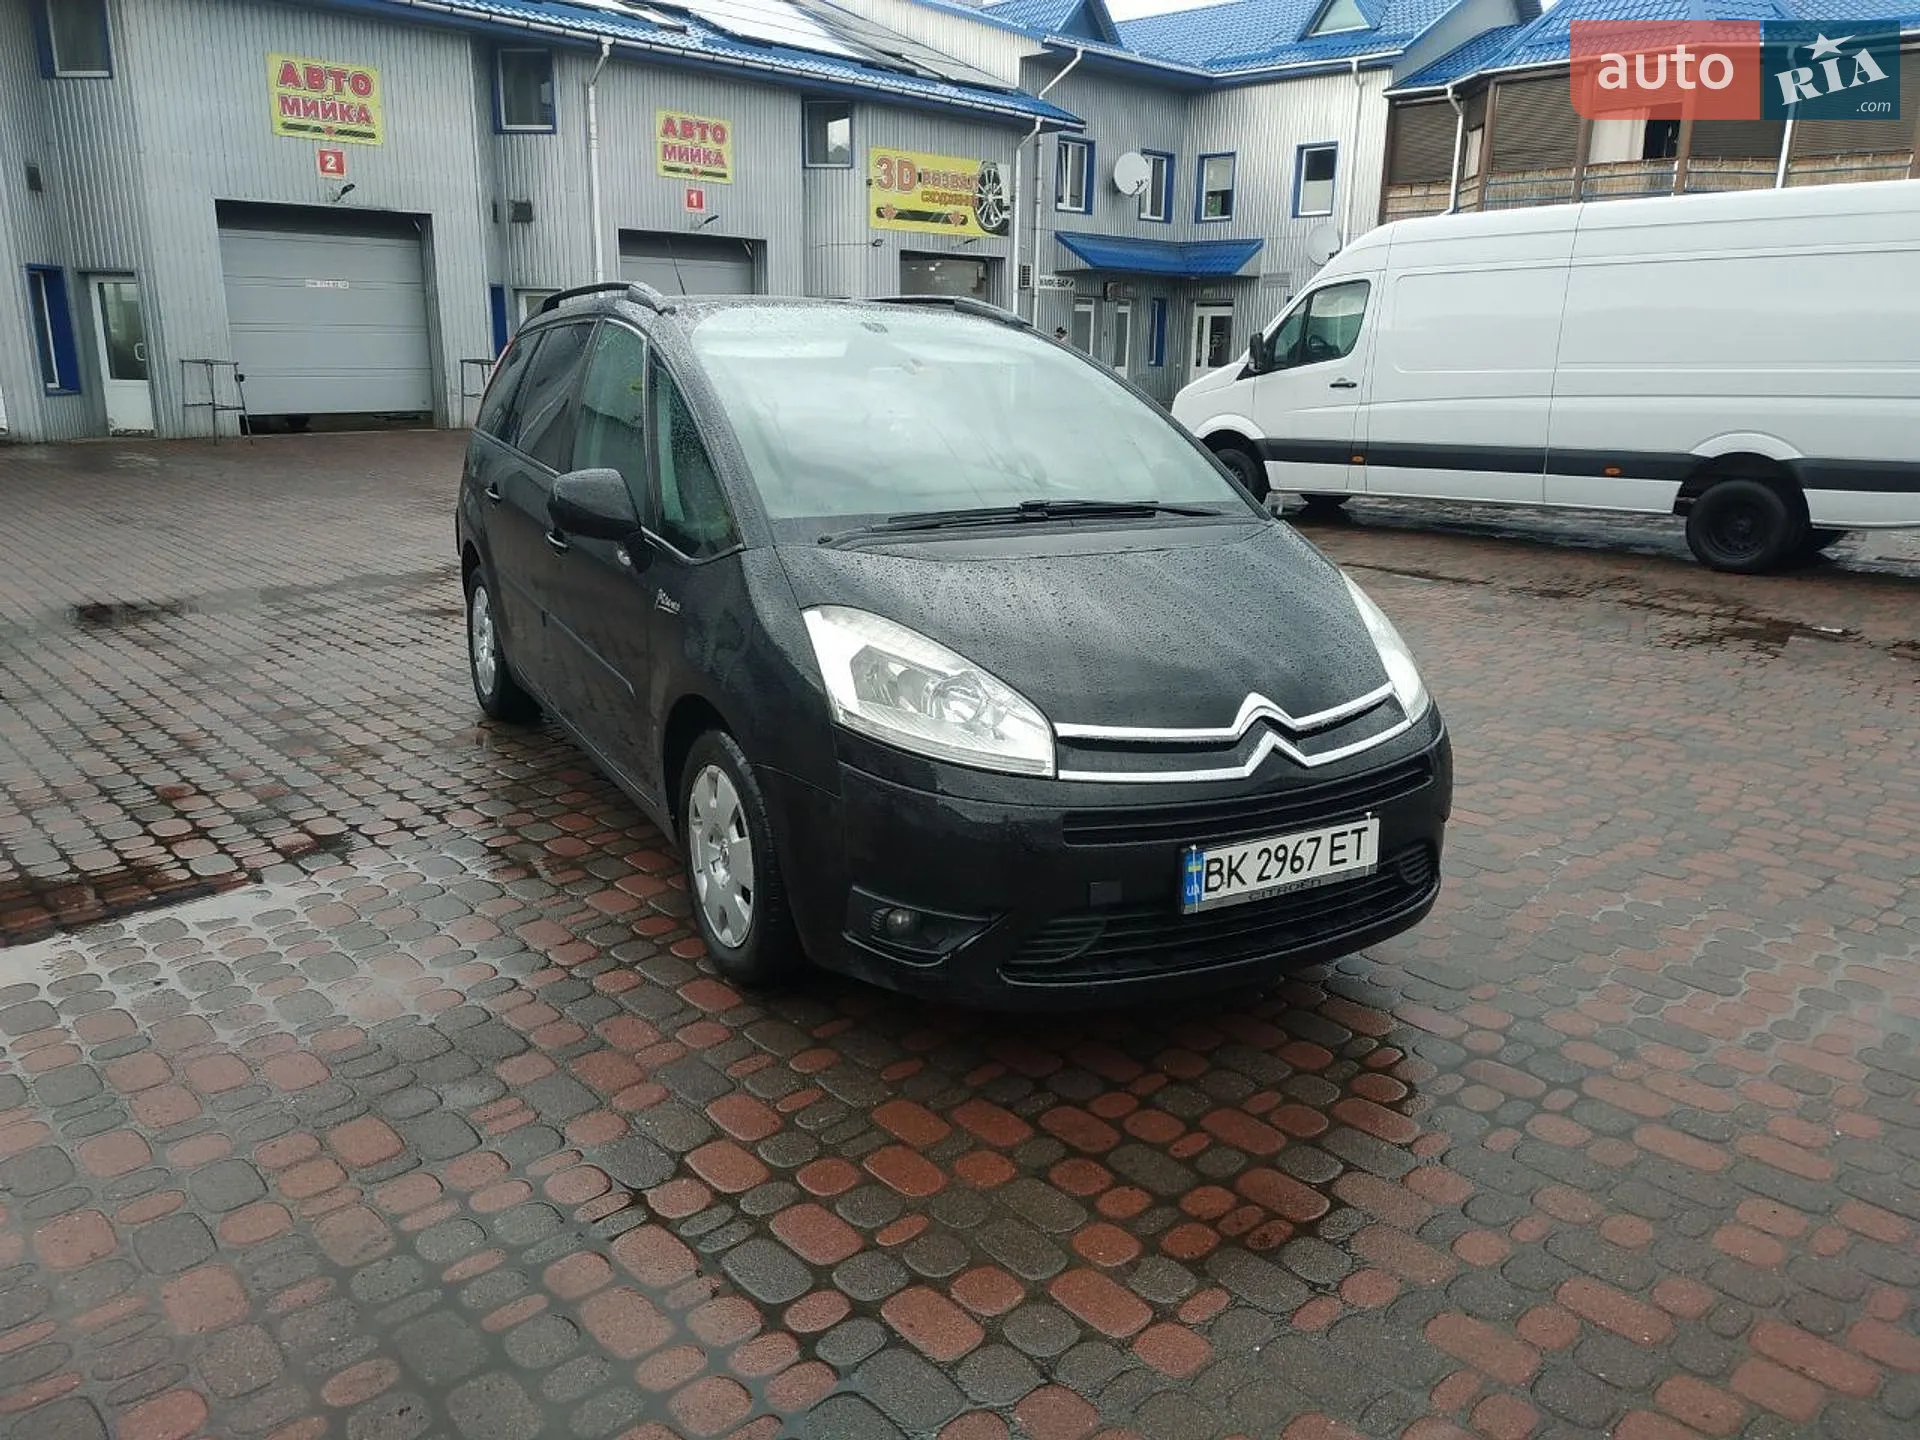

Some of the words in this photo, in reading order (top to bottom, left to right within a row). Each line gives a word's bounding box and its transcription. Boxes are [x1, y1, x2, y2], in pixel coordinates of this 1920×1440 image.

[277, 61, 374, 98] АВТО
[278, 94, 375, 126] МИЙКА
[661, 116, 727, 146] АВТО
[325, 155, 337, 170] 2
[661, 142, 726, 168] МИЙКА
[874, 155, 917, 194] 3D
[689, 191, 698, 207] 1
[1204, 851, 1248, 893] BK
[1256, 837, 1322, 883] 2967
[1329, 827, 1369, 867] ET
